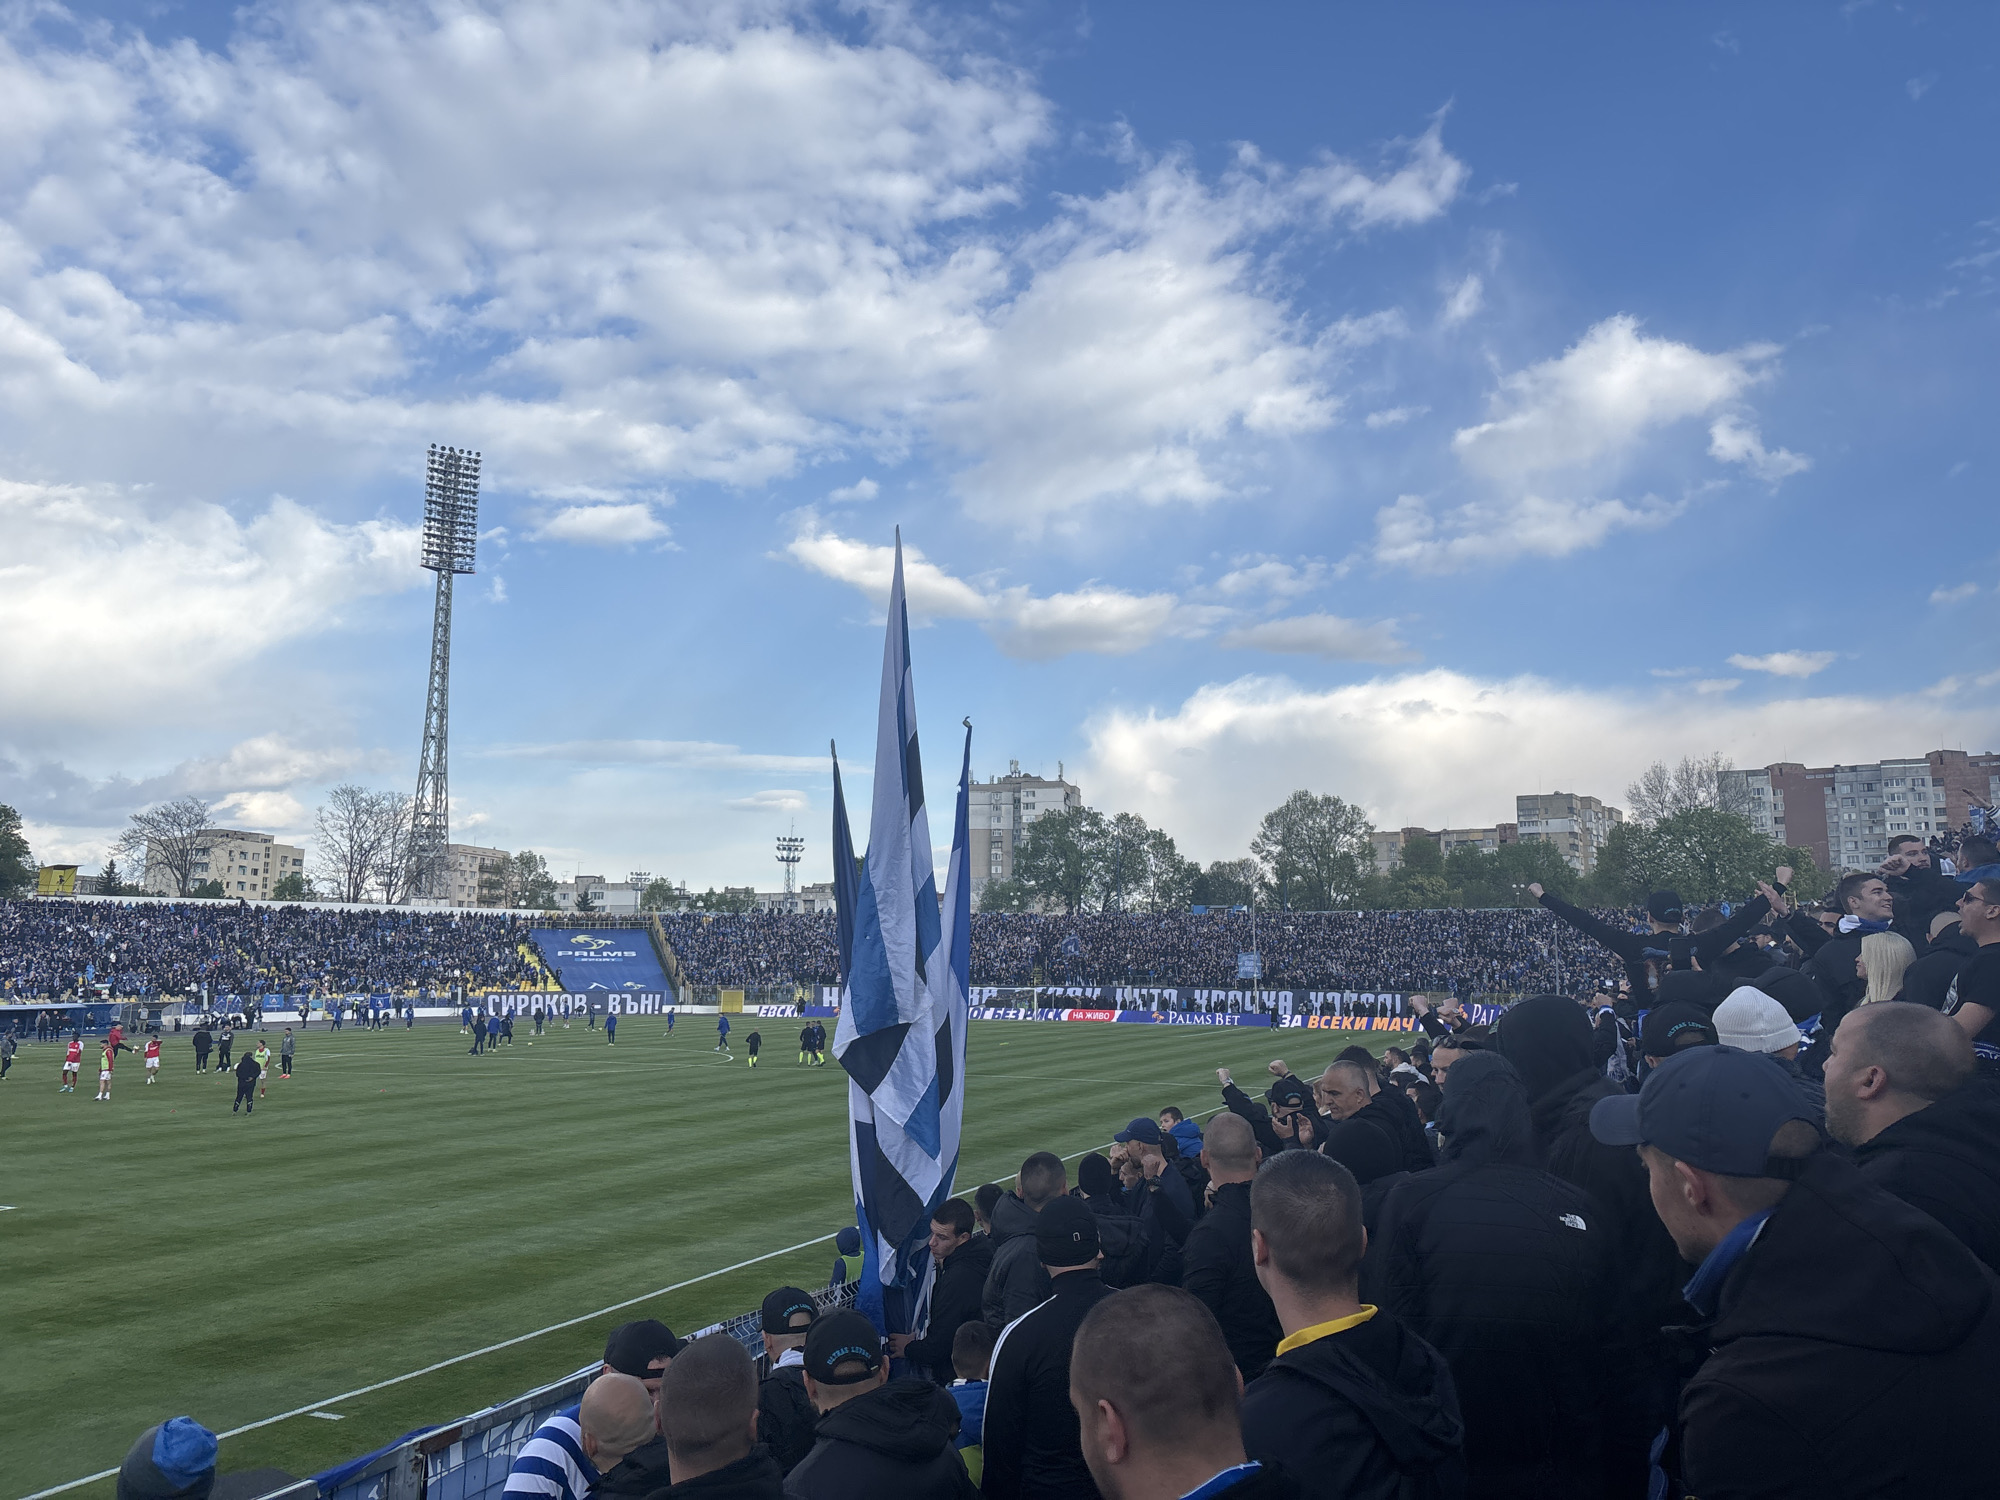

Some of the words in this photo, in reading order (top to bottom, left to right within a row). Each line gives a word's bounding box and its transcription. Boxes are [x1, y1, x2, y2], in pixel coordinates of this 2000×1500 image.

[487, 994, 587, 1016] СИРАКОВ
[608, 994, 661, 1015] ВЪН!
[991, 1007, 1021, 1020] БЕЗ
[1072, 1011, 1084, 1019] НА
[1085, 1012, 1110, 1020] ЖИВО
[1279, 1015, 1302, 1028] ЗА
[1307, 1015, 1369, 1031] ВСЕКИ
[1371, 1017, 1415, 1032] МАЧ
